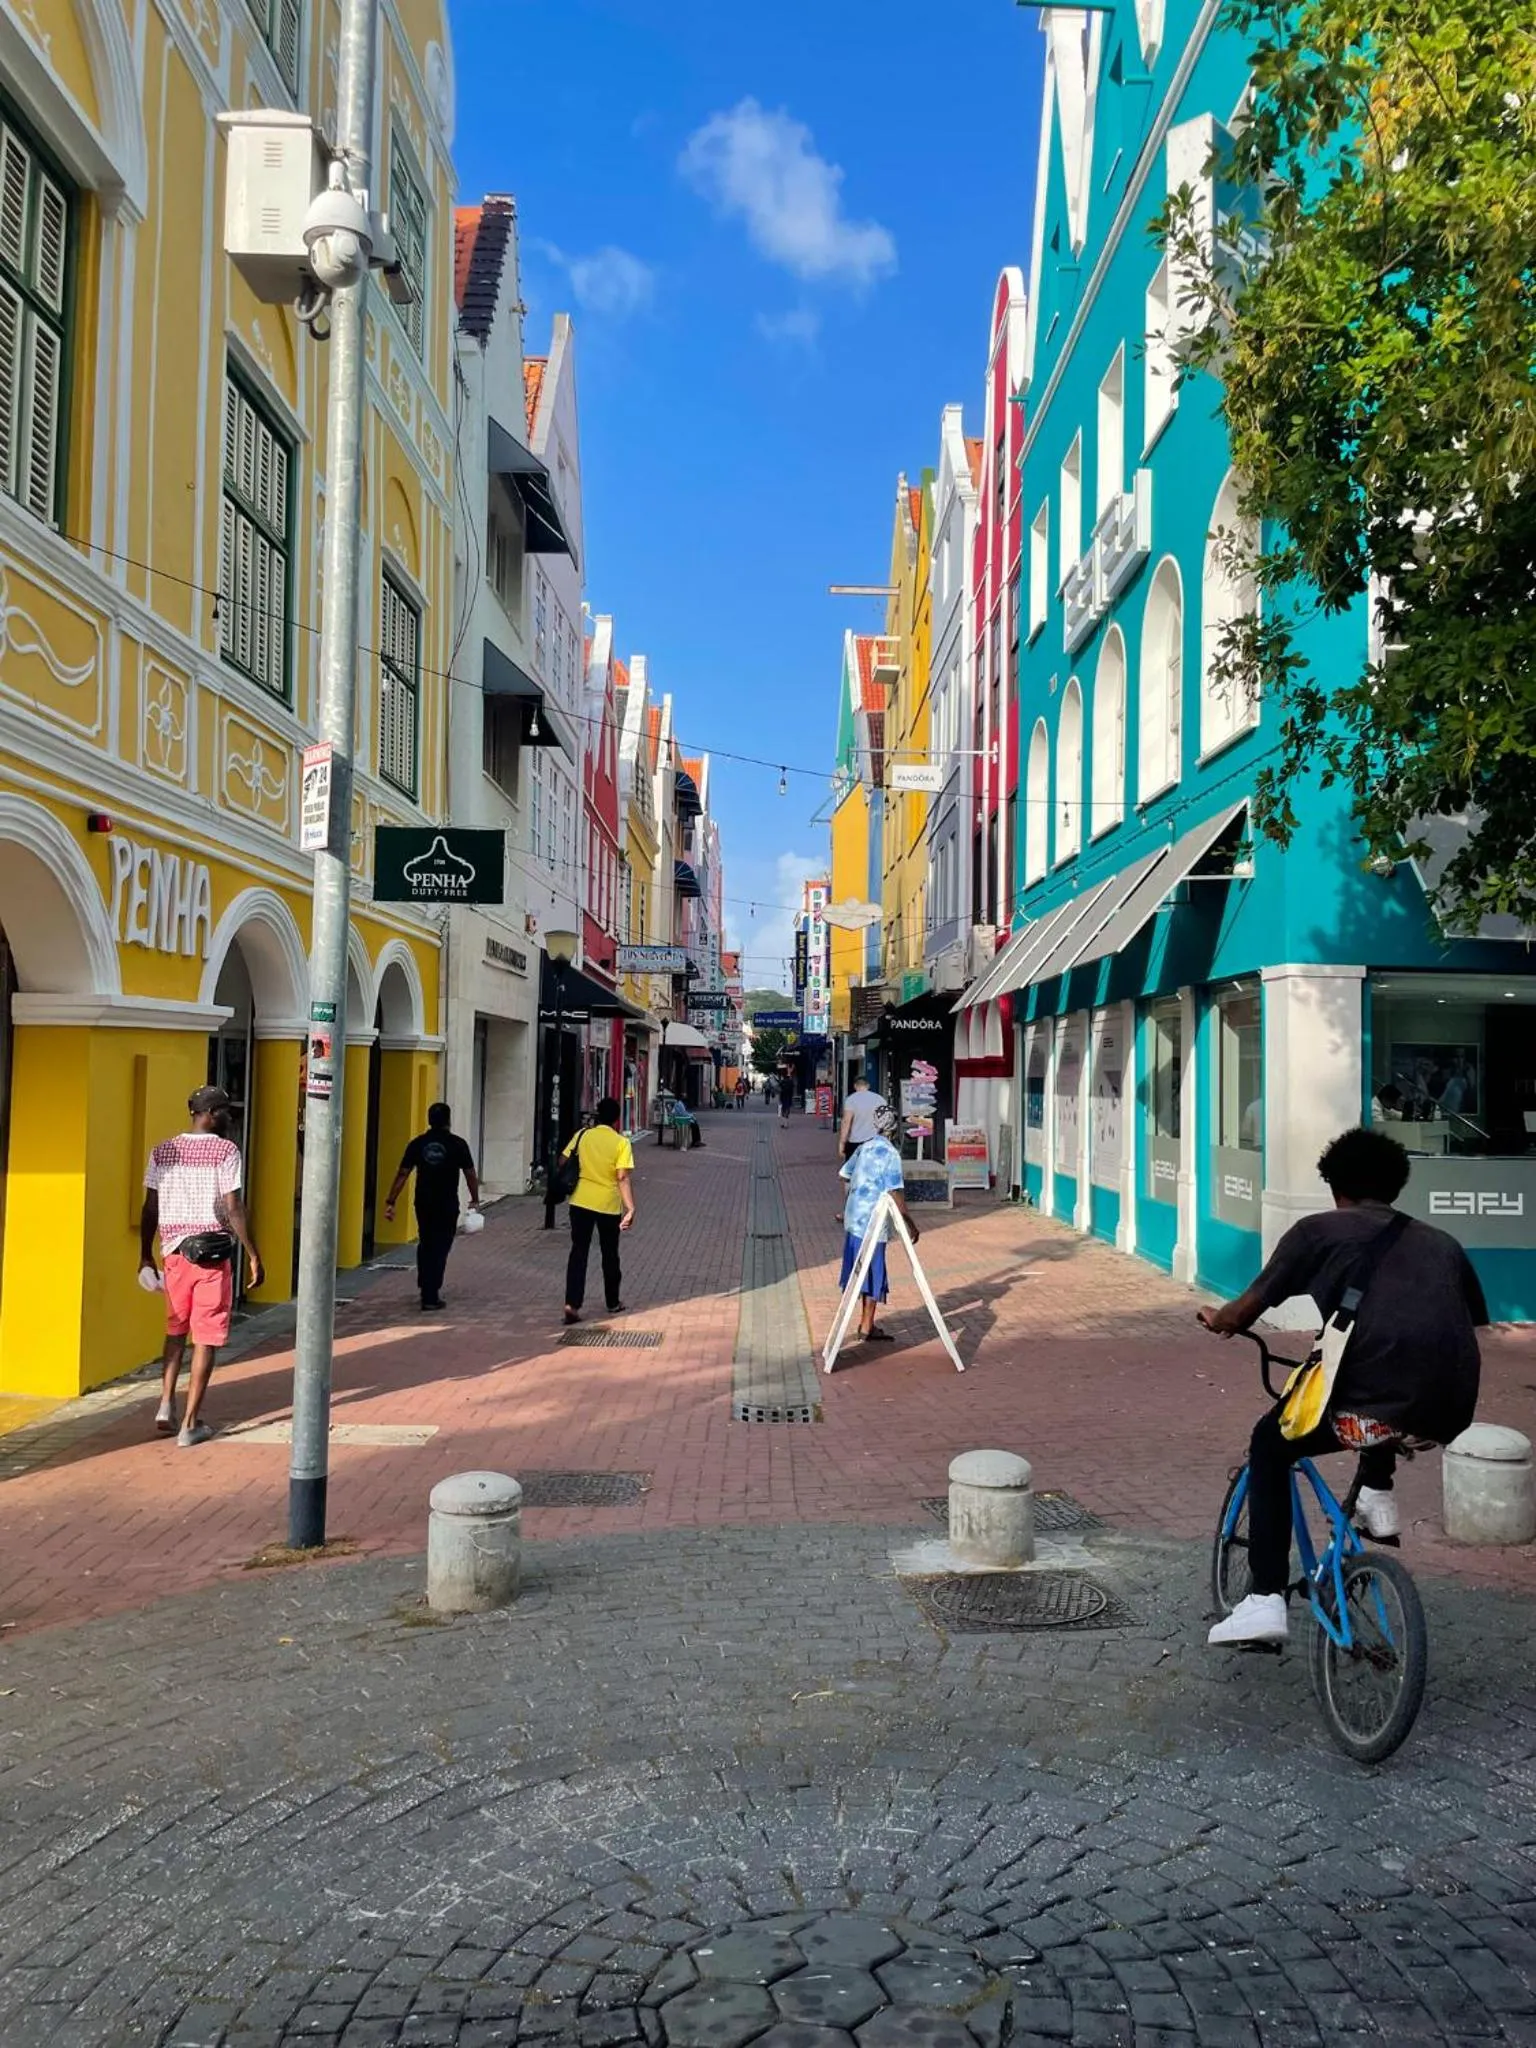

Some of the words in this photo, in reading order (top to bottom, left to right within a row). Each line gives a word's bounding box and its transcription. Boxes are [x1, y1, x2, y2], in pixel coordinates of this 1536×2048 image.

[411, 872, 468, 889] PENHA
[108, 835, 212, 960] PENHA
[1429, 1191, 1524, 1216] EFFY
